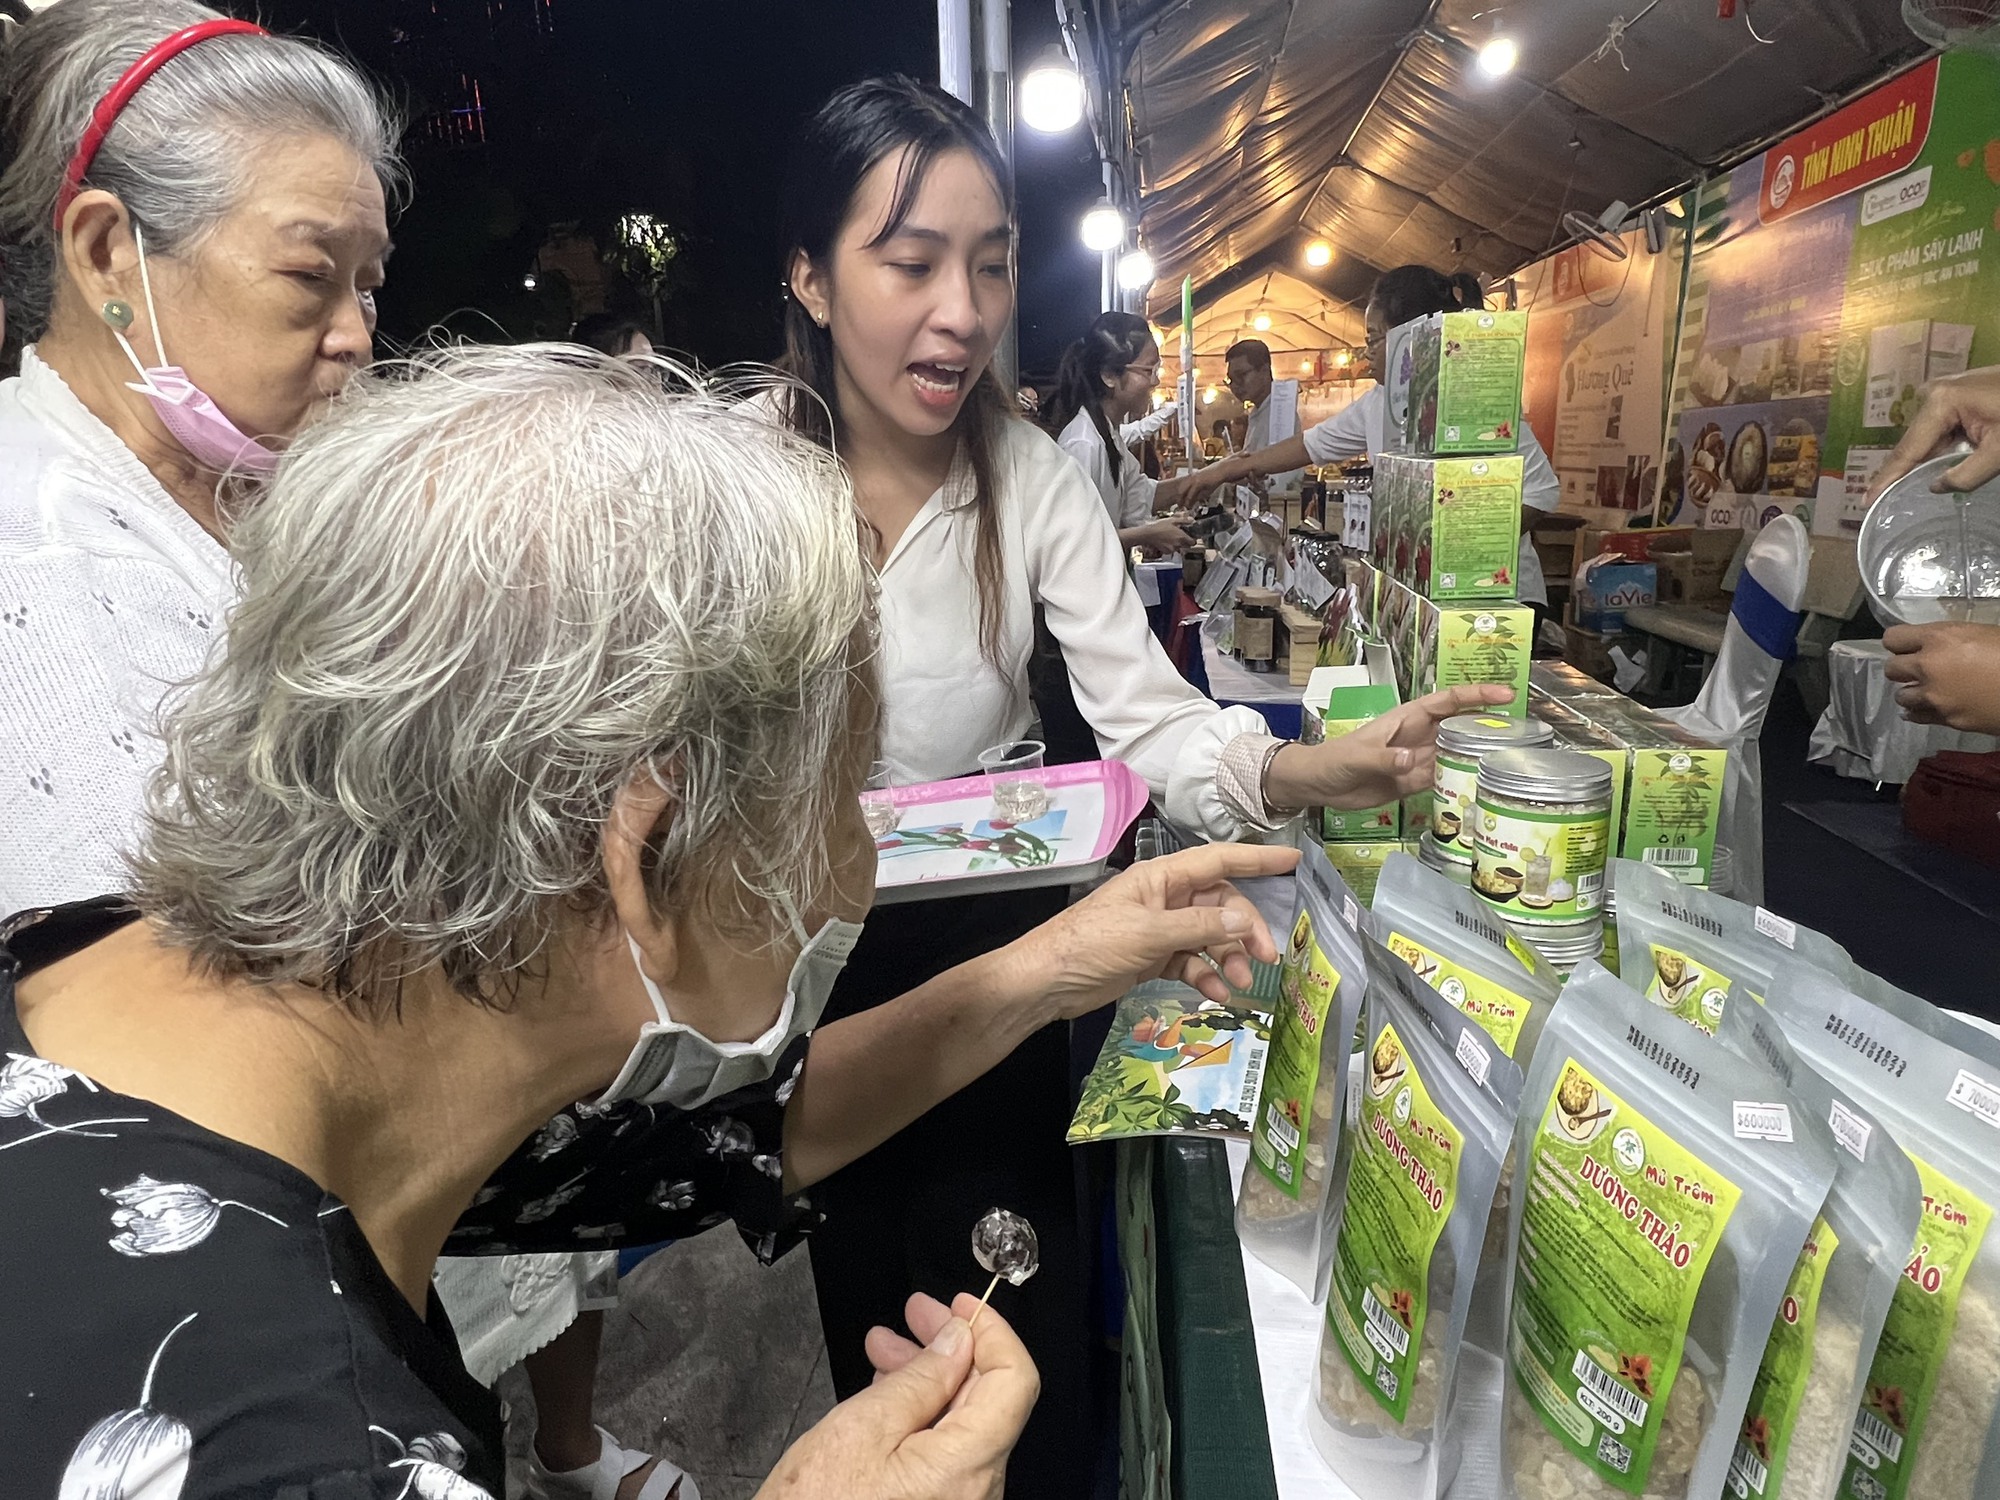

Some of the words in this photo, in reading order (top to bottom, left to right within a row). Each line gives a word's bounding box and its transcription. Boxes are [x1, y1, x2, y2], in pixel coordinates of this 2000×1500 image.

[1829, 128, 1865, 178] NINH
[1866, 100, 1916, 162] THUẬN
[1487, 1002, 1515, 1017] Trôm
[1427, 1126, 1452, 1152] Trôm
[1373, 1110, 1408, 1168] DƯƠNG
[1410, 1157, 1443, 1210] THẢO
[1646, 1165, 1667, 1187] Mủ
[1673, 1175, 1714, 1205] Trôm
[1580, 1155, 1638, 1219] DƯƠNG
[1638, 1208, 1691, 1267] THẢO
[1922, 1196, 1967, 1226] Trôm
[1904, 1245, 1941, 1292] ẢO
[1596, 1406, 1612, 1423] 200
[1613, 1421, 1620, 1431] g
